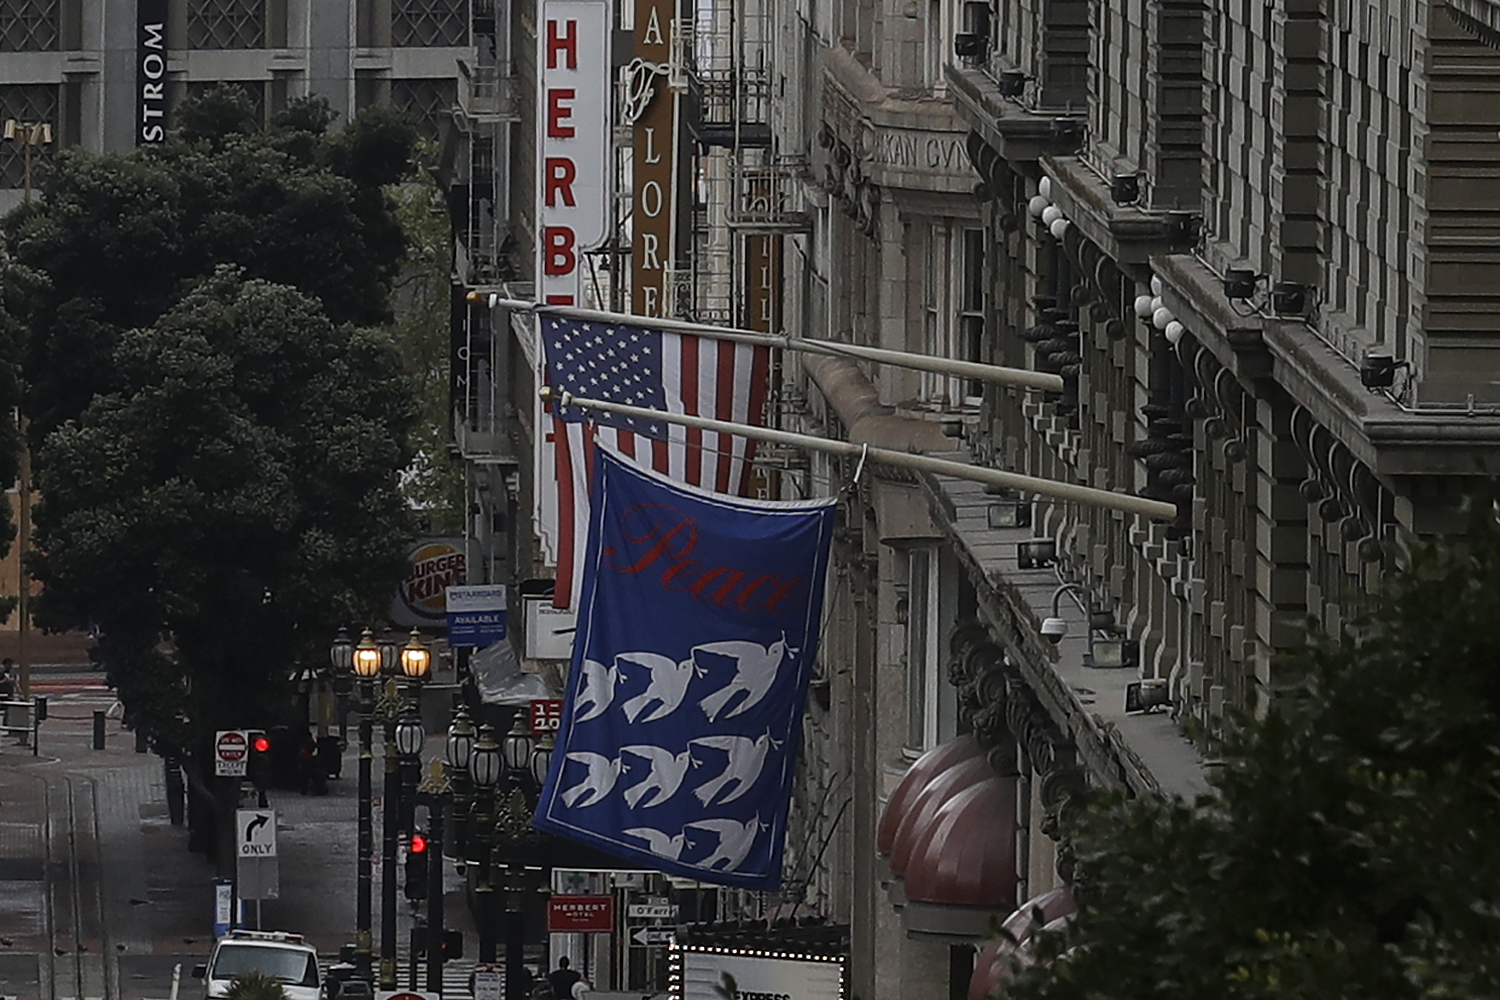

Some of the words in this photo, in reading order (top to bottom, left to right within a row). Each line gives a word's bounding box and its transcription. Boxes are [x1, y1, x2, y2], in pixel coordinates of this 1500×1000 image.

[545, 19, 577, 305] HERB
[406, 553, 467, 583] URGER
[454, 614, 500, 625] AVAILABLE
[242, 844, 272, 854] ONLY
[553, 903, 607, 912] HERBERT
